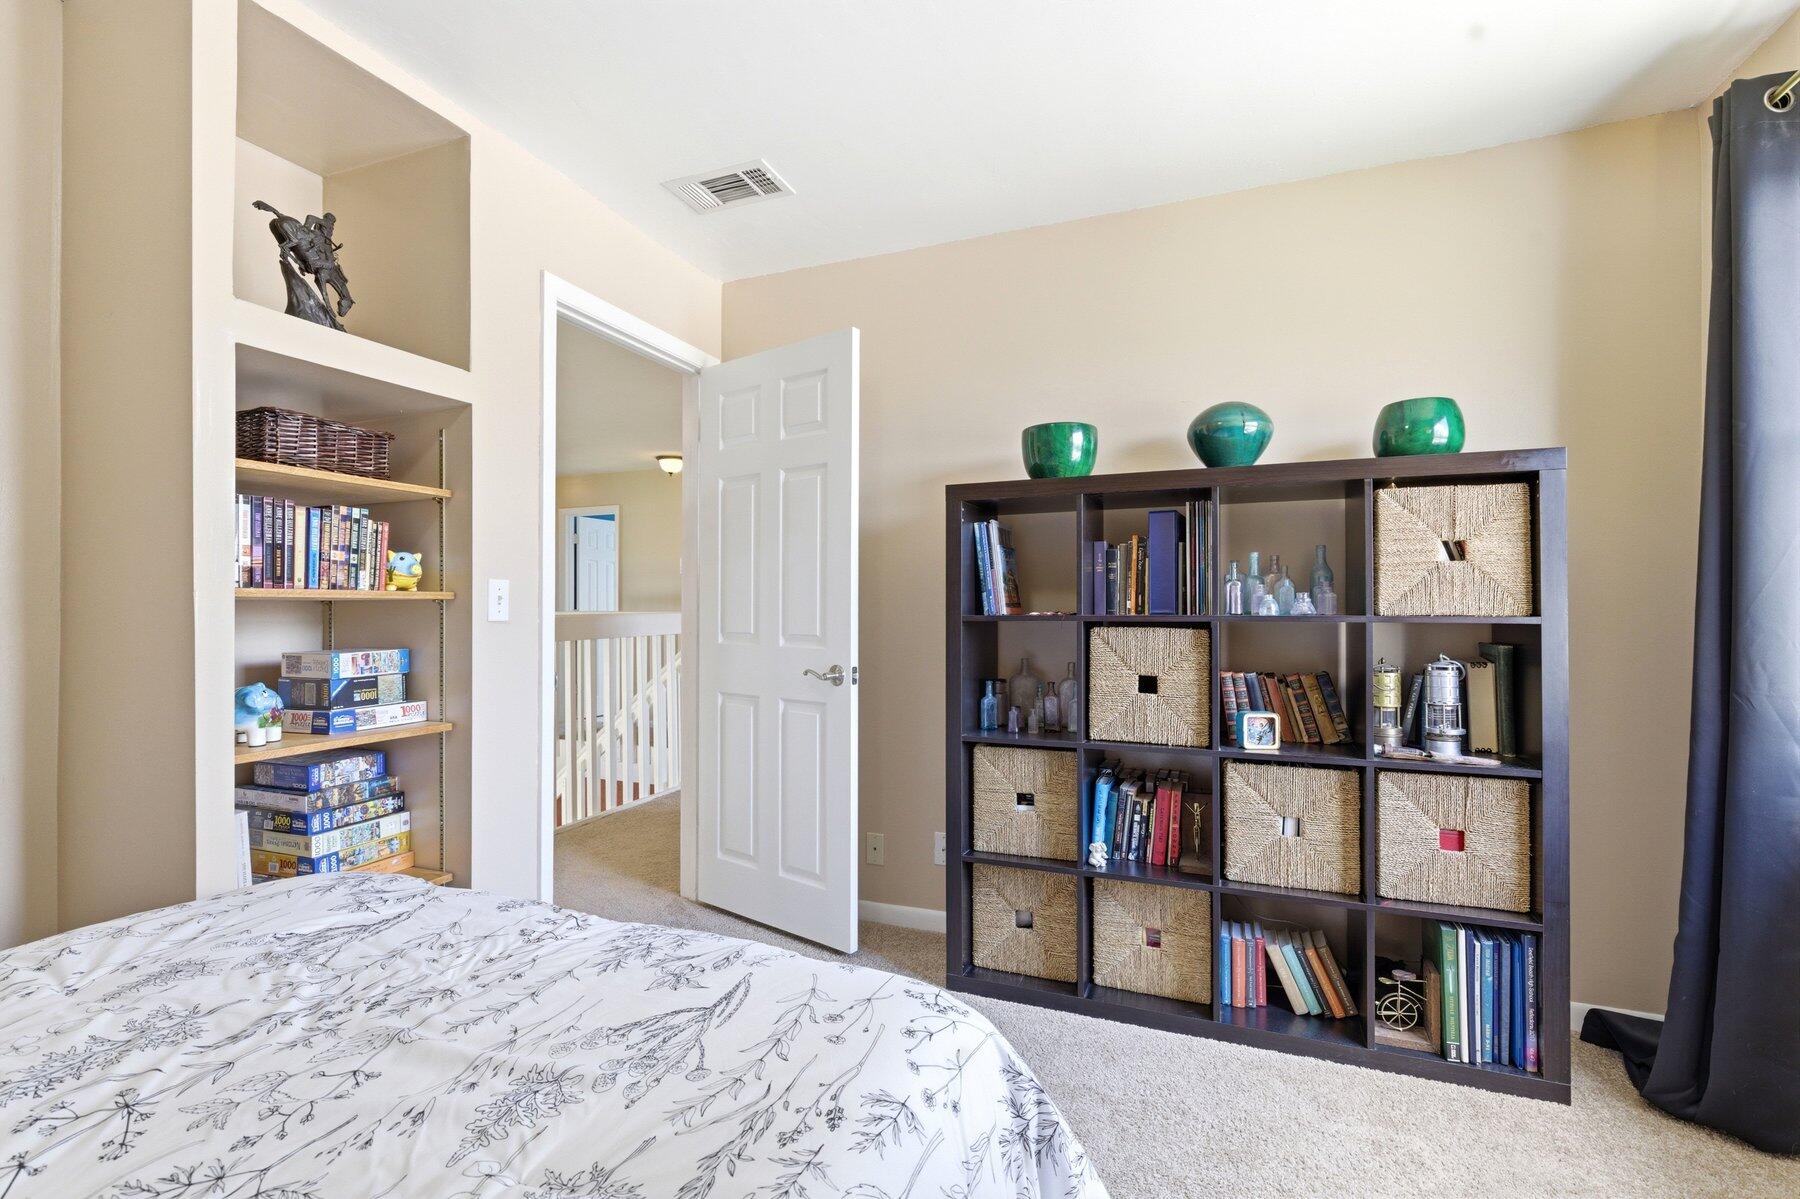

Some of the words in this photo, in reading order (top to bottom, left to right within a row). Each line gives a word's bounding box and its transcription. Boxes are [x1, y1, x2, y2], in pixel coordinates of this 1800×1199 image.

[360, 690, 378, 701] 1000
[400, 704, 421, 717] 1000
[290, 713, 307, 722] 1000
[274, 816, 291, 826] 1000
[323, 812, 331, 830] 1000
[314, 837, 322, 857] 1000
[279, 859, 297, 870] 1000
[329, 855, 337, 872] 1000
